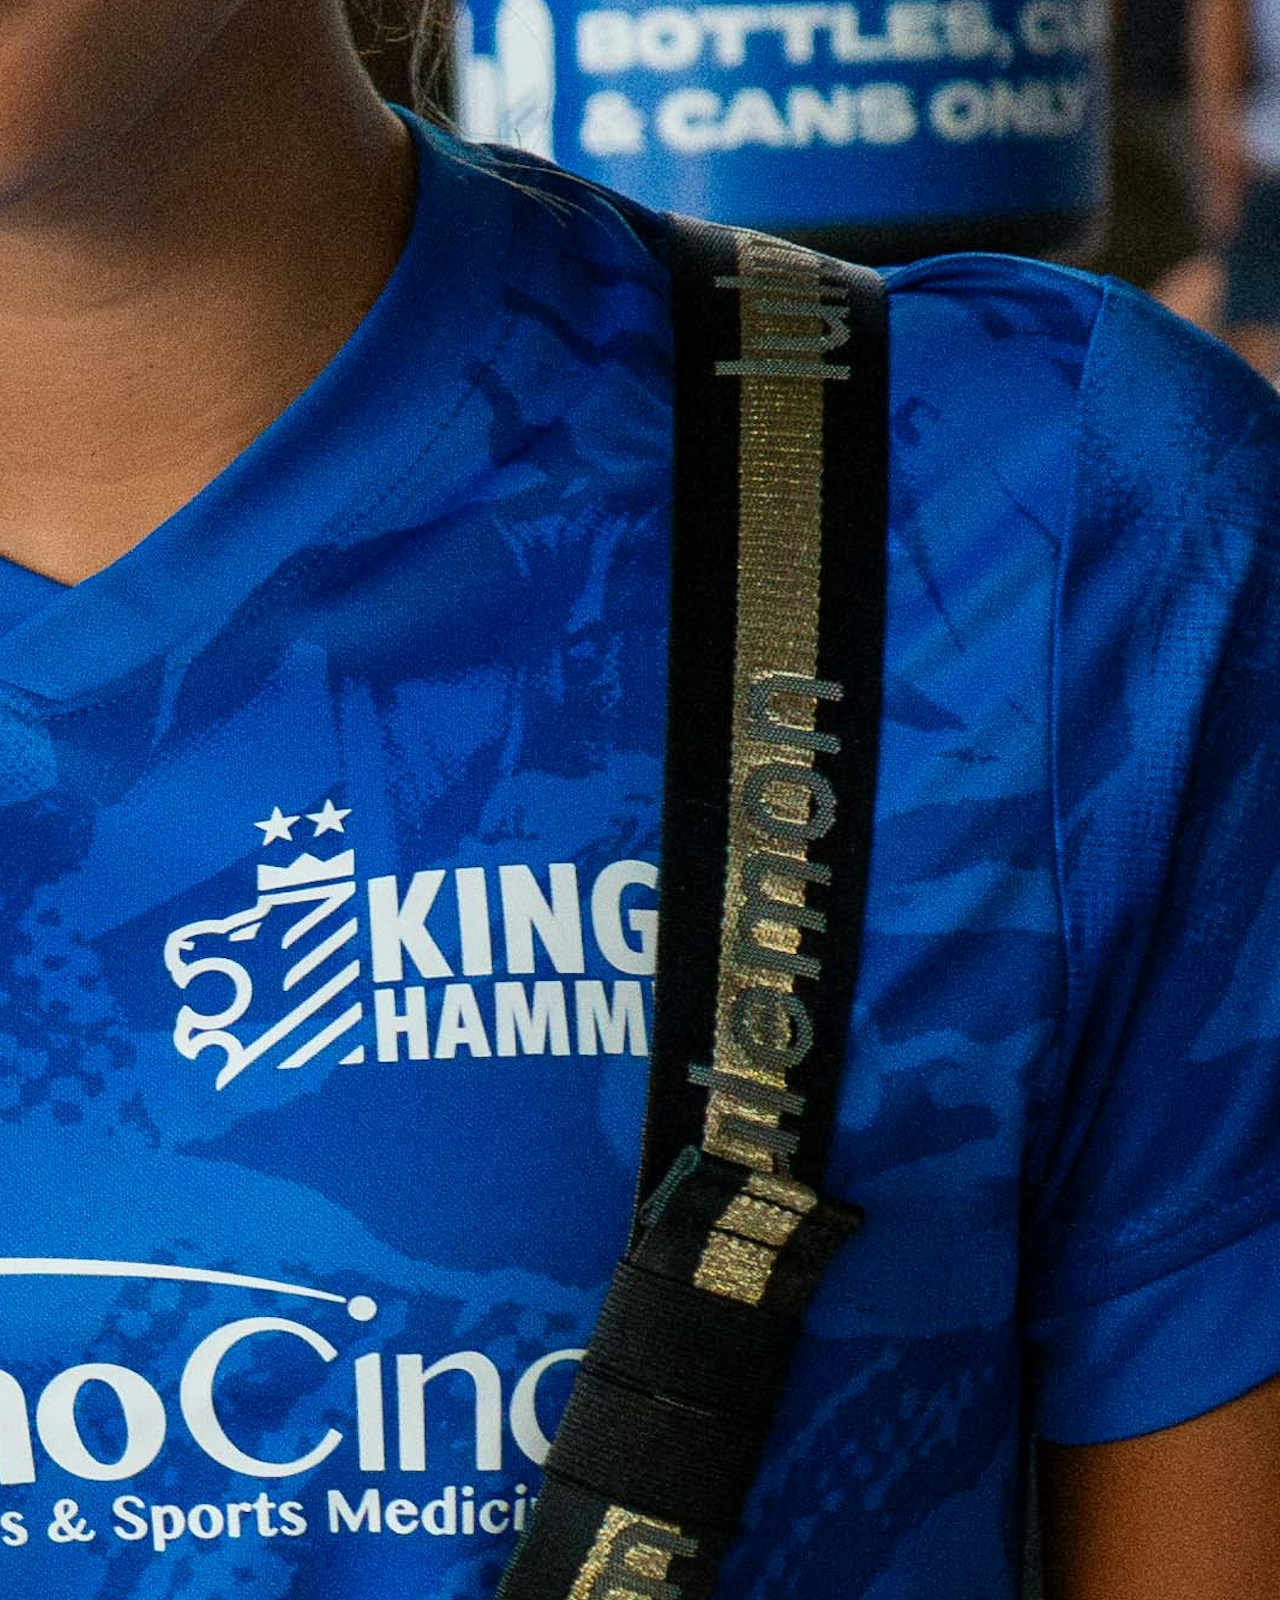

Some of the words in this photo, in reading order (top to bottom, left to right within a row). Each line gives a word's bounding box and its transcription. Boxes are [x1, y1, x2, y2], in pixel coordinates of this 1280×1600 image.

[578, 90, 646, 156] &
[654, 81, 918, 153] CANS
[927, 78, 1092, 143] ONLY
[367, 860, 660, 983] KING
[374, 980, 656, 1062] HAMM
[47, 1498, 96, 1543] &
[112, 1492, 308, 1552] Sports
[327, 1483, 538, 1537] Medici
